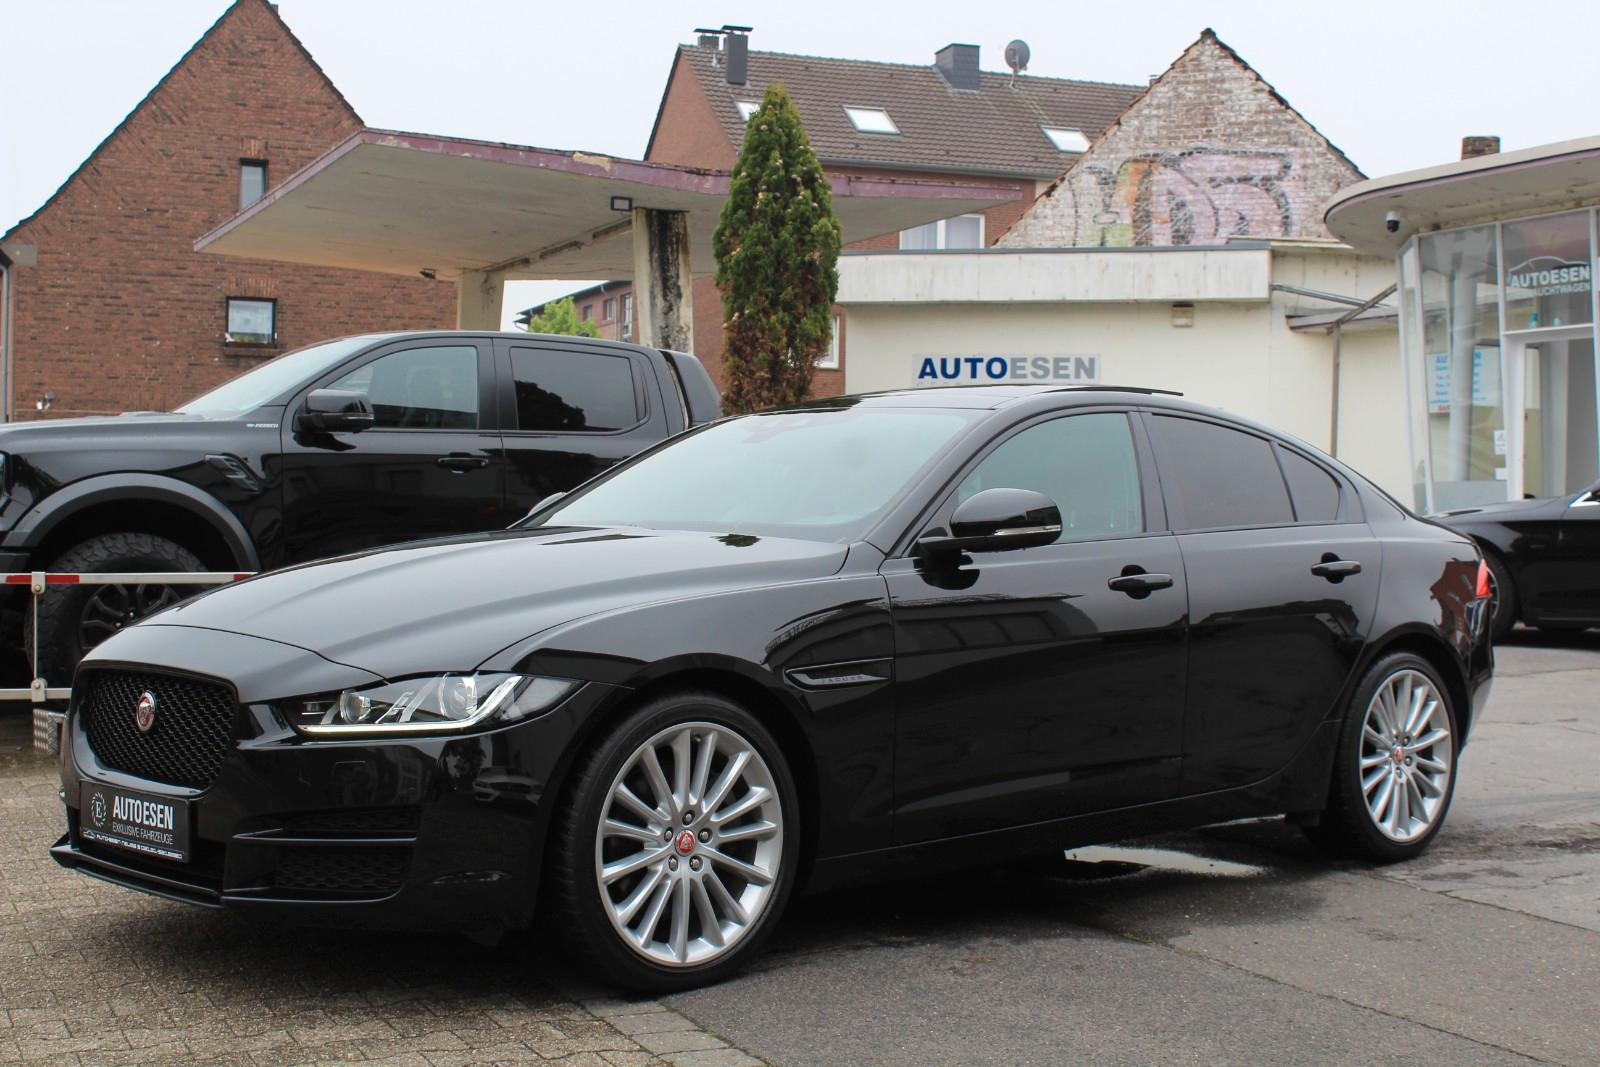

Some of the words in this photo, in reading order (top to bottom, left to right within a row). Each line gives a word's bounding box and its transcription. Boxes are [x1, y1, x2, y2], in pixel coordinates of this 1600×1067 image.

[1511, 266, 1590, 288] AUTOESEN
[918, 357, 1096, 379] AUTOESEN
[113, 795, 174, 830] AUTOESEN
[140, 828, 174, 845] FAHRZEUGE
